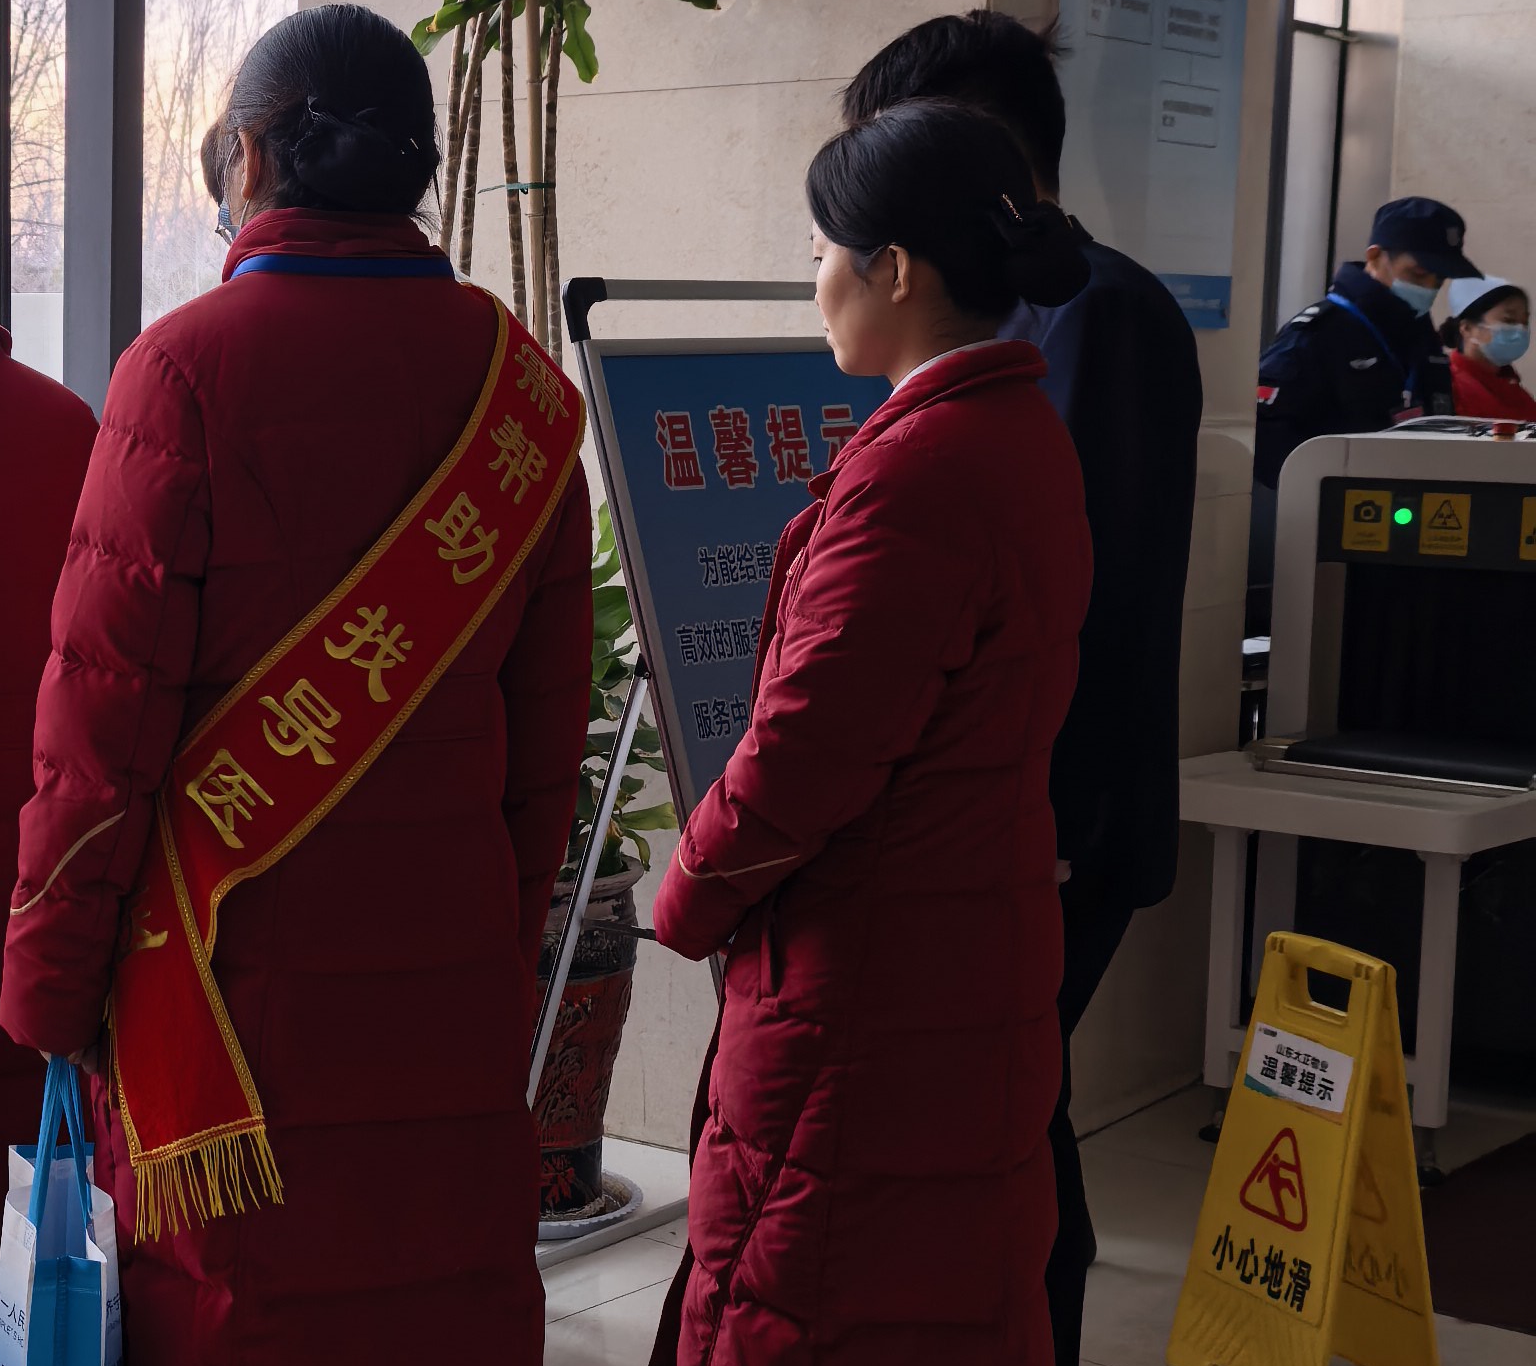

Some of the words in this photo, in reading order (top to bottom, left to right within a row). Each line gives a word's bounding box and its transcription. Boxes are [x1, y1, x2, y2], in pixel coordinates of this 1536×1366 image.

[655, 405, 859, 490] 温馨提示
[185, 343, 570, 849] 需帮助找导医
[698, 543, 779, 589] 为能给患
[1260, 1054, 1335, 1101] 温馨提示
[1212, 1224, 1312, 1313] 小心地滑
